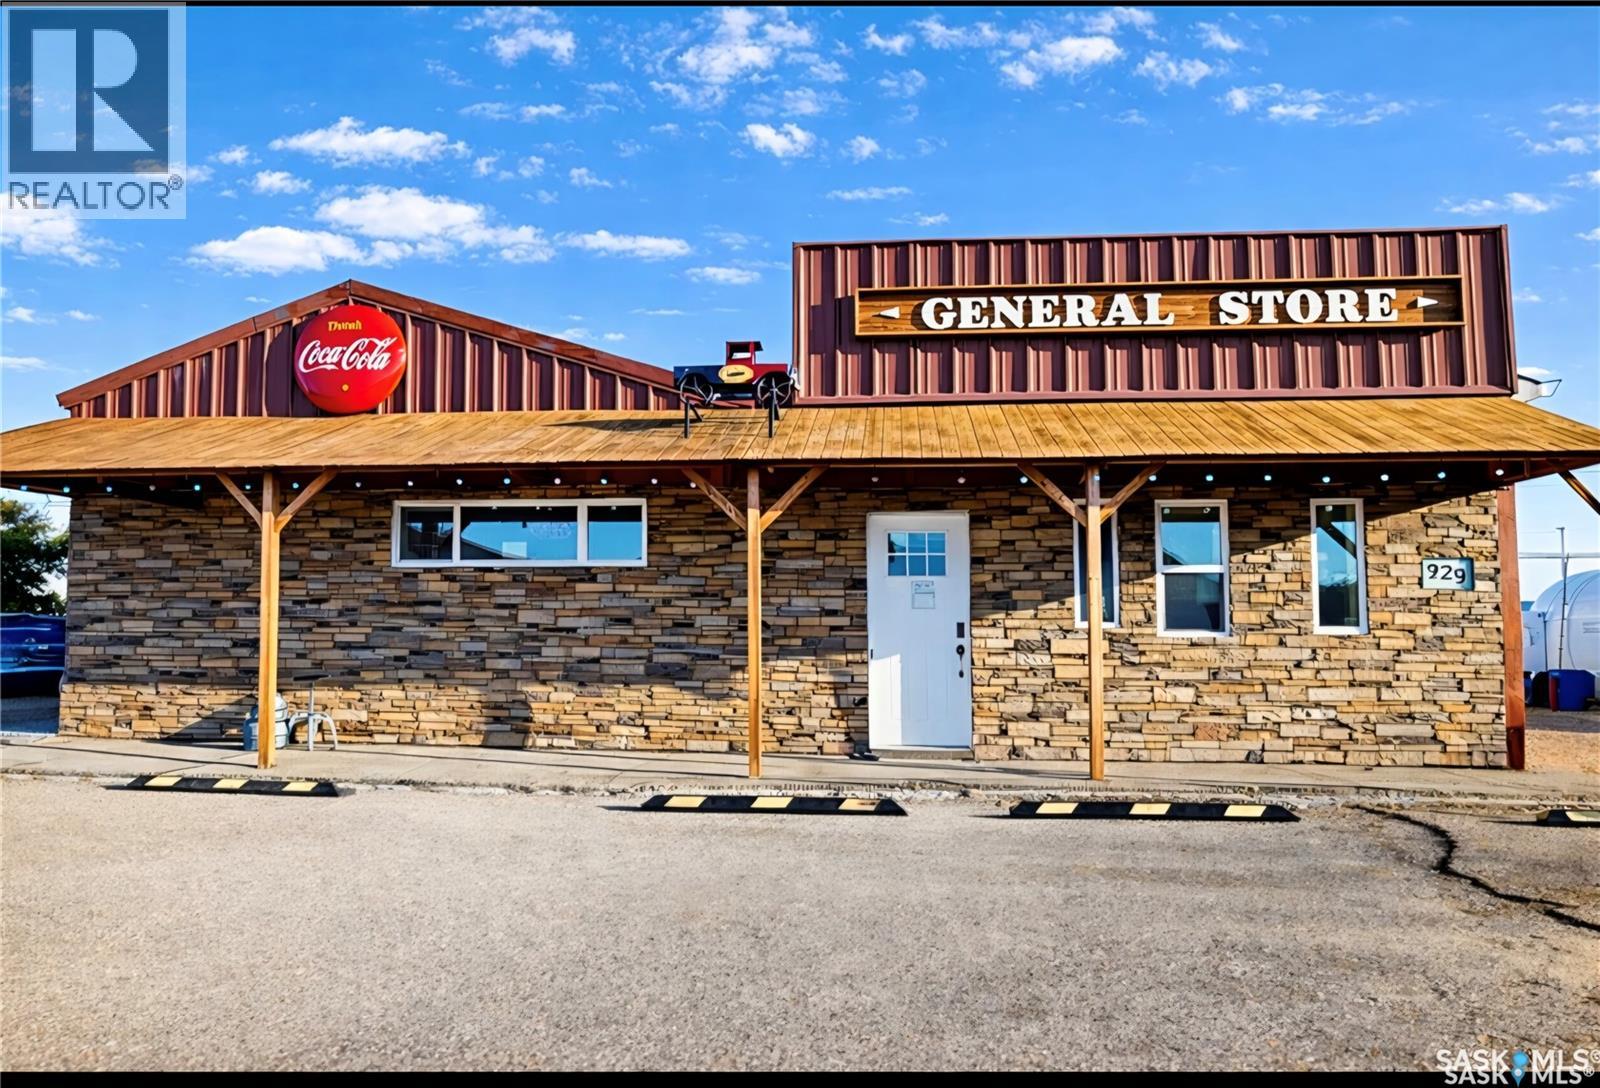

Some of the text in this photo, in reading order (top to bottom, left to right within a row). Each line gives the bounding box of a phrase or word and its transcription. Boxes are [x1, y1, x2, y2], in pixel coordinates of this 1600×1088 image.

[920, 287, 1399, 330] GENERAL STORE
[1427, 563, 1466, 584] 929
